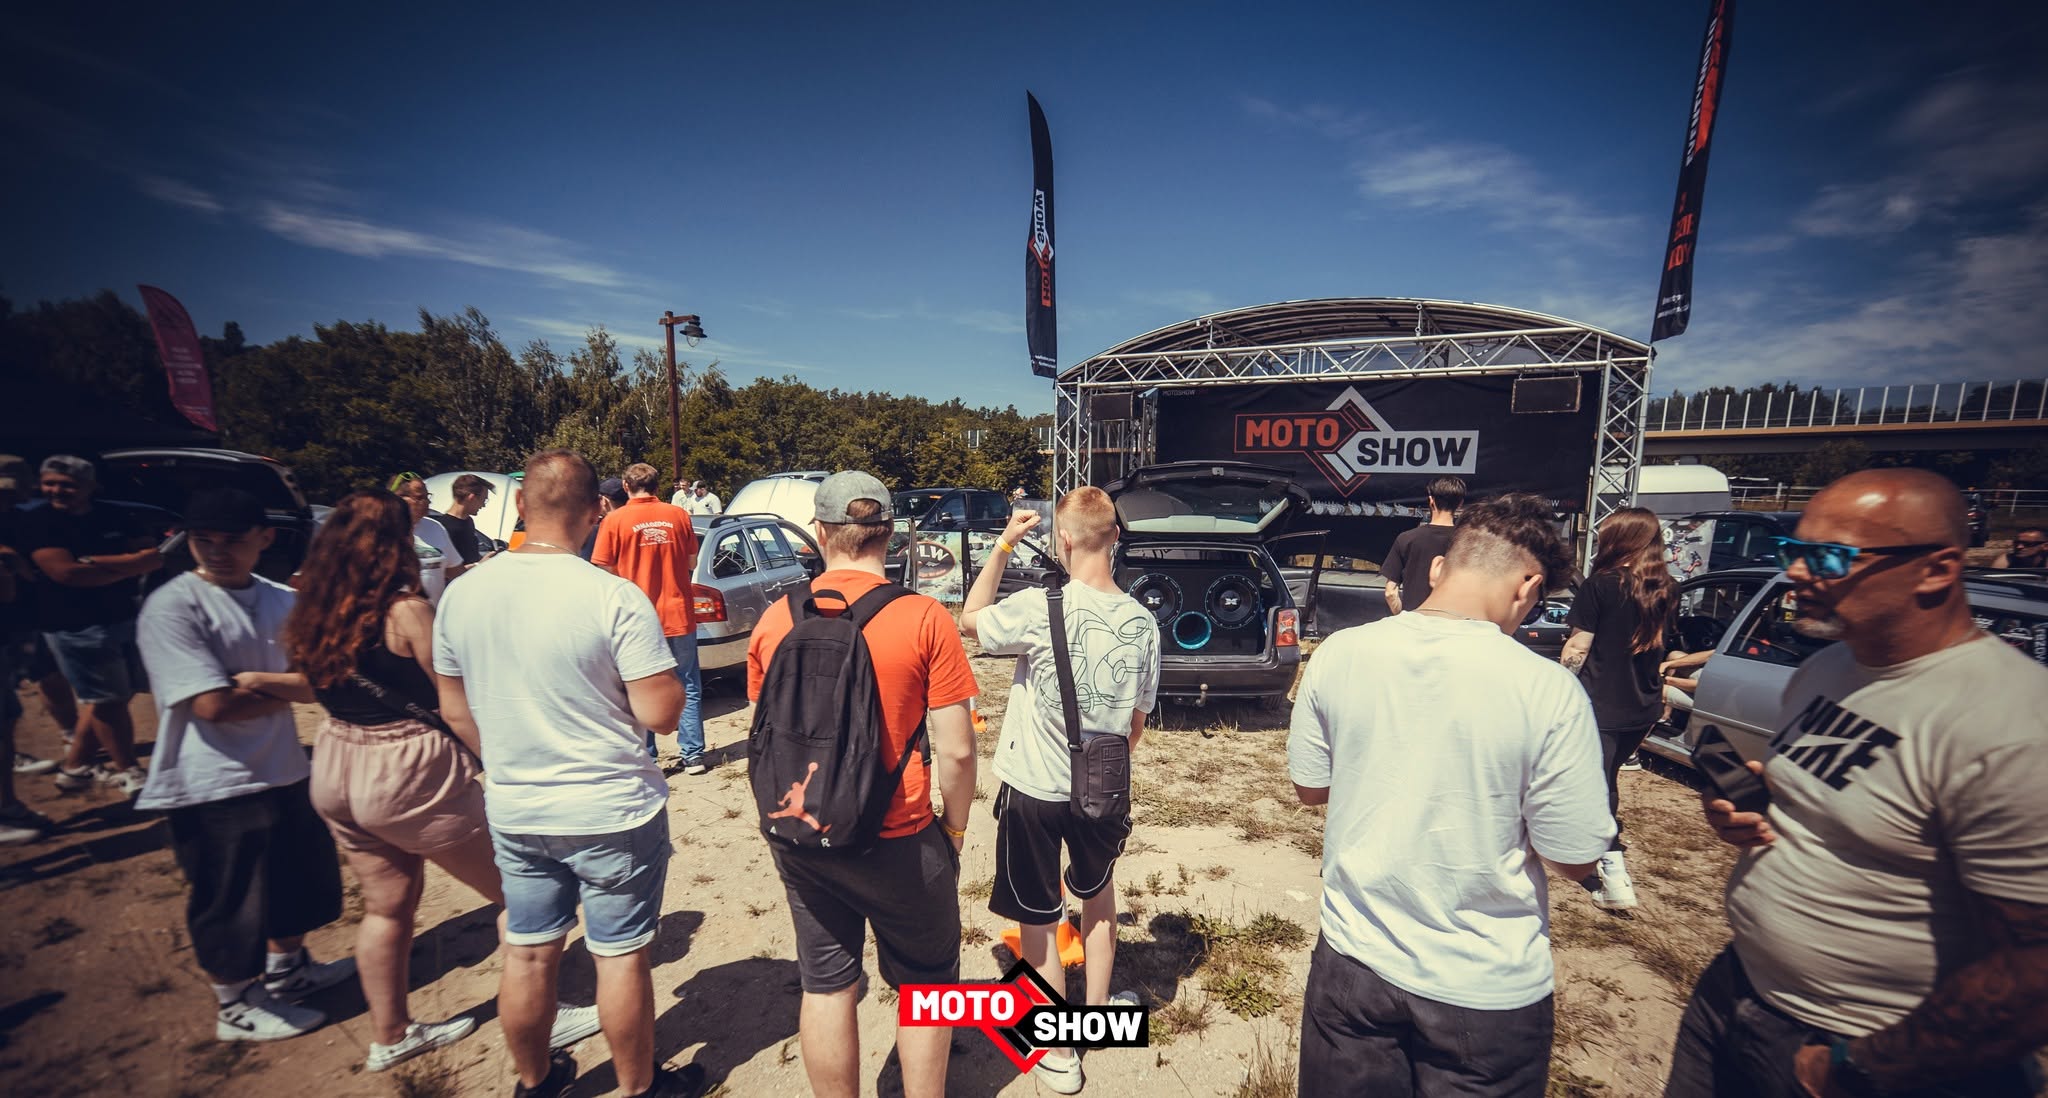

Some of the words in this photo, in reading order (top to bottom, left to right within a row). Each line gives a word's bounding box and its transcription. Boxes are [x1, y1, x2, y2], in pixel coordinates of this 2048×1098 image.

[1245, 417, 1340, 448] MOTO
[1356, 437, 1472, 467] SHOW
[905, 545, 949, 561] LW
[1770, 695, 1903, 791] NIKE
